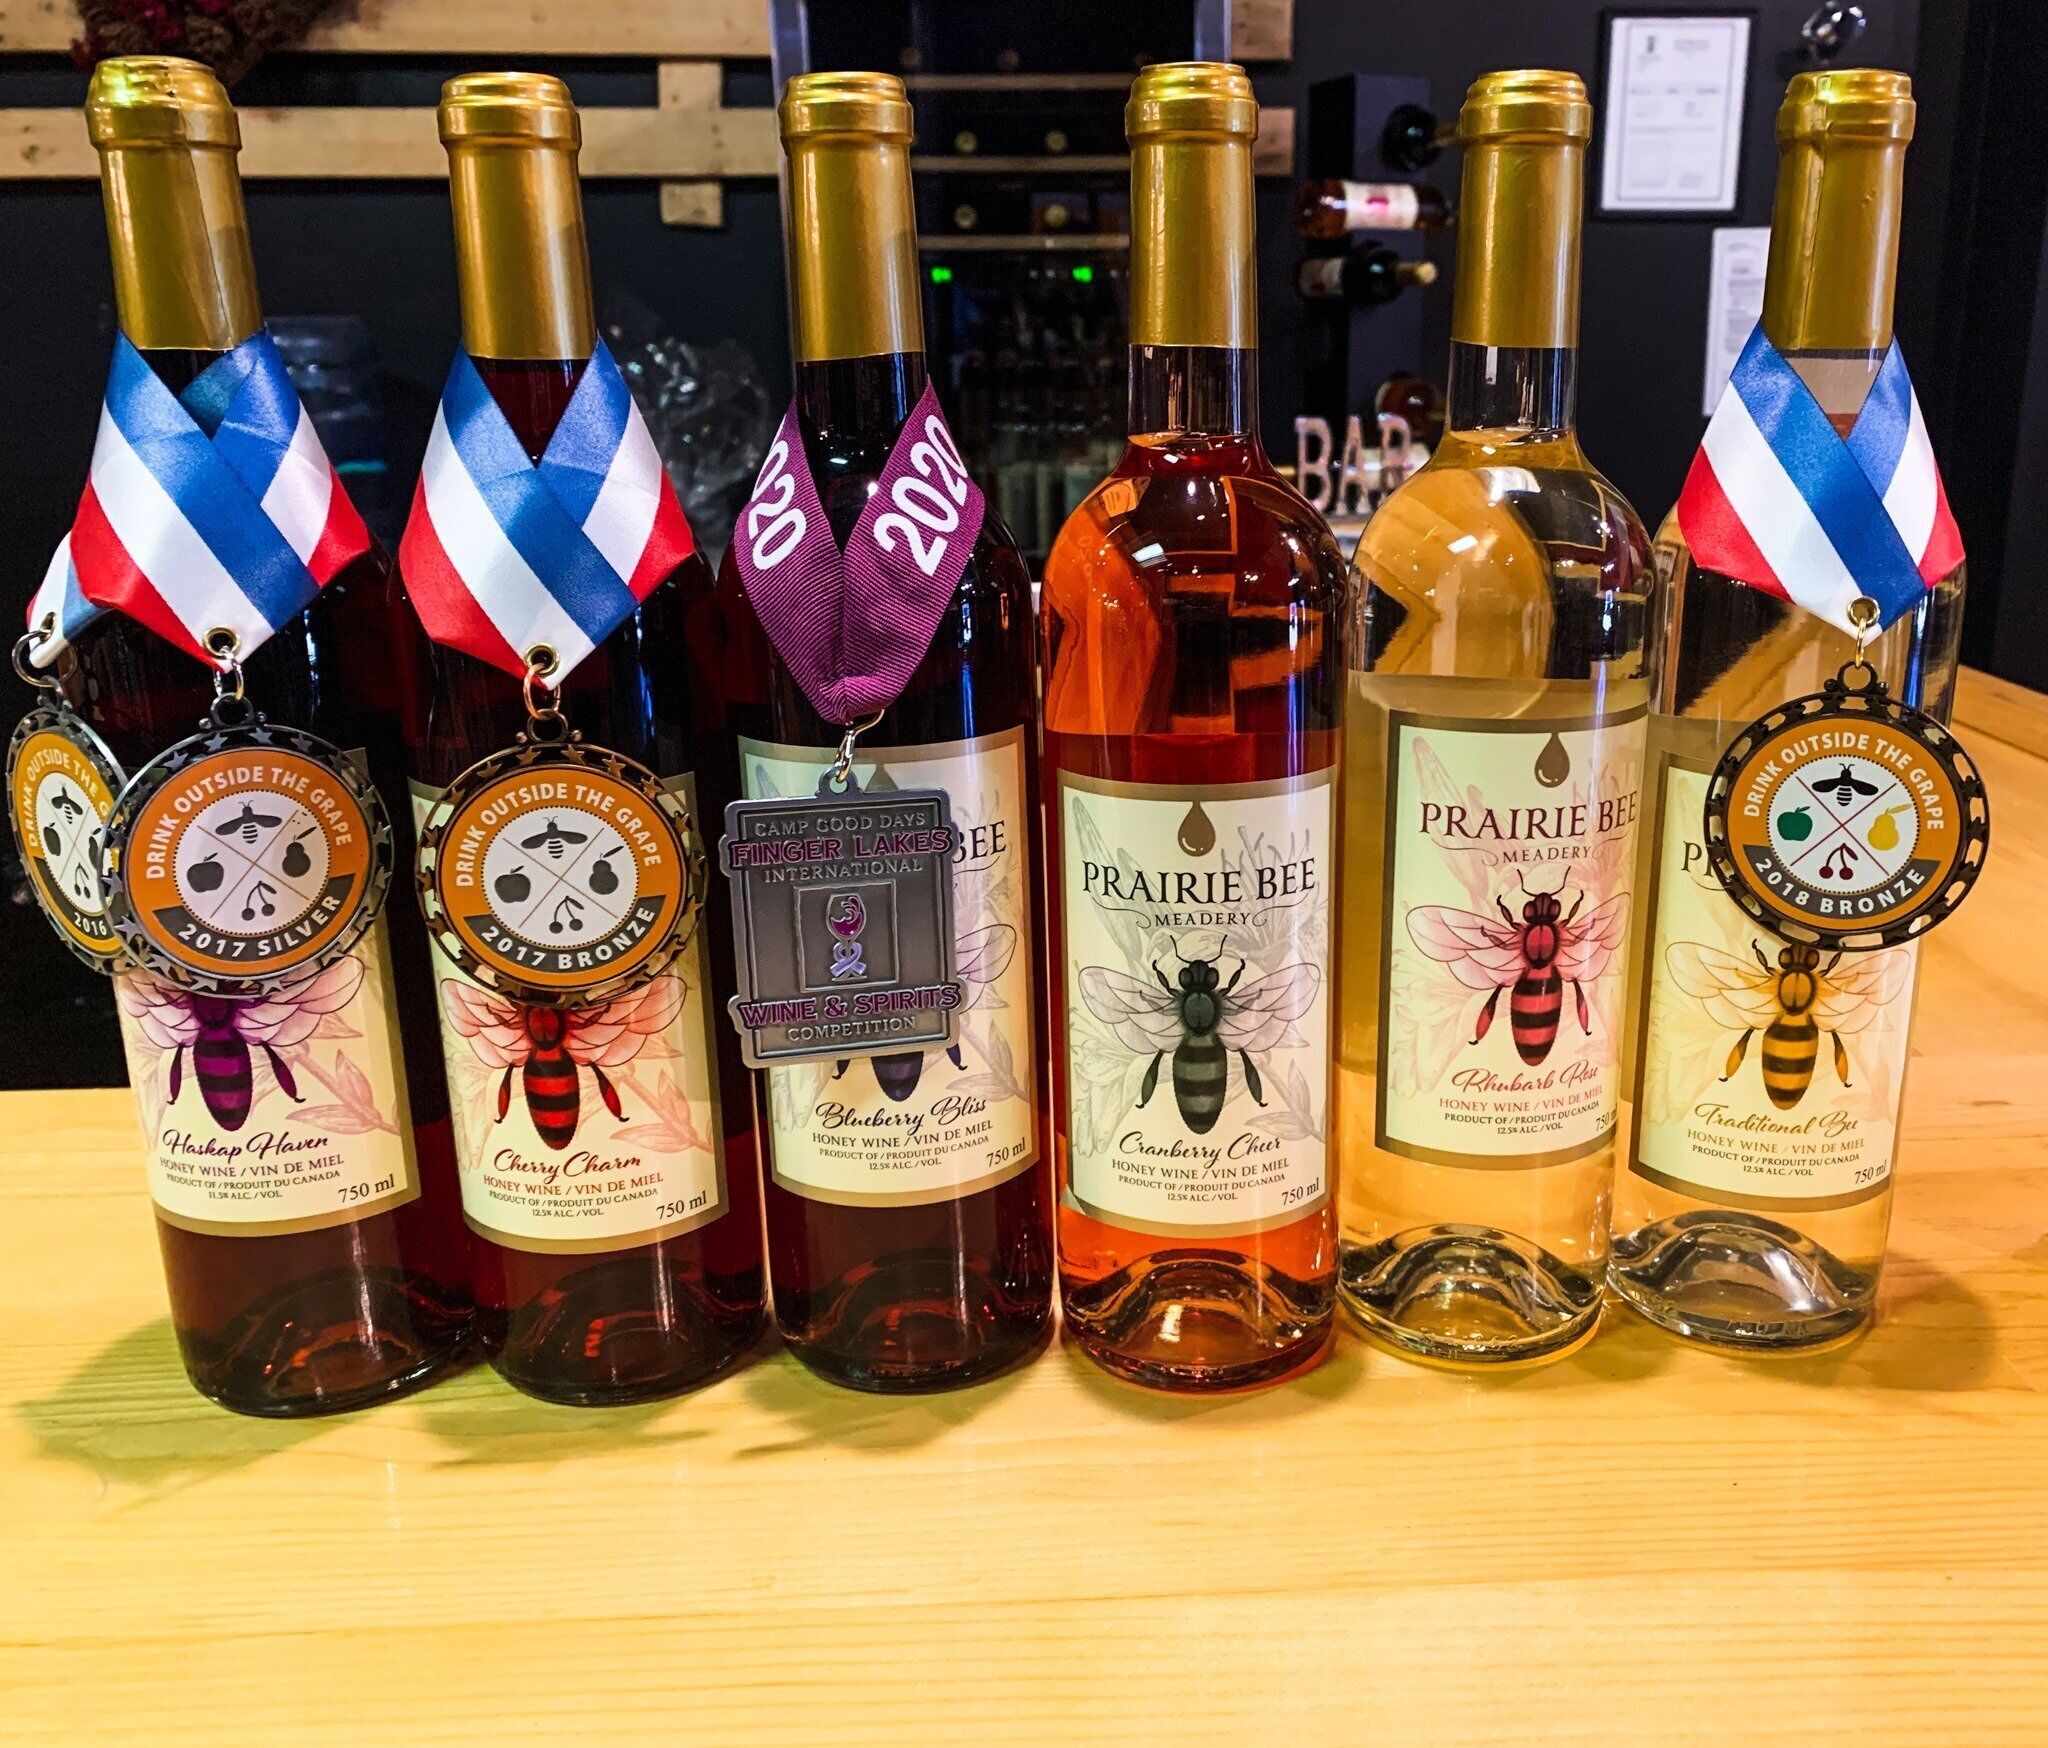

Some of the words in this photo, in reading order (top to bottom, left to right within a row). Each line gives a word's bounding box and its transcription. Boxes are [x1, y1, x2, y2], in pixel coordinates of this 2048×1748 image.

[1294, 415, 1411, 517] BAR
[748, 414, 807, 570] 020
[873, 414, 969, 577] 2020
[26, 749, 71, 782] OUTSIDE
[72, 759, 99, 798] THE
[1744, 760, 1782, 818] DRINK
[1781, 731, 1870, 764] OUTSIDE
[1875, 739, 1913, 770] THE
[1909, 768, 1944, 831] GRAPE
[23, 784, 39, 846] DRINK
[146, 815, 179, 879] DRINK
[174, 765, 263, 813] OUTSIDE
[270, 766, 310, 794] THE
[309, 787, 352, 846] GRAPE
[754, 820, 809, 837] CAMP
[816, 816, 872, 833] GOOD
[880, 812, 925, 828] DAYS
[1419, 801, 1588, 841] PRAIRIE
[1596, 790, 1637, 834] BEE
[456, 825, 486, 887] DRINK
[480, 783, 568, 825] OUTSIDE
[575, 784, 615, 813] THE
[615, 807, 661, 867] GRAPE
[732, 837, 842, 867] FINGER
[855, 830, 951, 858] LAKES
[1502, 846, 1592, 864] MEADERY
[765, 858, 923, 883] INTERNATIONAL
[1082, 860, 1244, 905] PRAIRIE
[1255, 857, 1316, 900] BEE
[1755, 858, 1809, 906] 2018
[1820, 868, 1925, 915] BRONZE
[74, 912, 107, 936] 2016
[179, 923, 246, 958] 2017
[257, 897, 341, 956] SILVER
[1154, 912, 1251, 927] MEADERY
[481, 925, 547, 967] 2017
[558, 907, 655, 970] BRONZE
[739, 1002, 817, 1027] WINE
[825, 996, 847, 1019] &
[854, 986, 960, 1014] SPIRITS
[788, 1016, 916, 1042] COMPETITION
[1451, 1067, 1554, 1093] Rhubarb
[1439, 1098, 1489, 1111] HONEY
[1493, 1101, 1530, 1111] WINE
[1542, 1097, 1565, 1109] VIN
[1568, 1093, 1582, 1104] DE
[1584, 1085, 1602, 1099] MIEL
[1445, 1113, 1492, 1124] PRODUCT
[1515, 1113, 1557, 1124] PRODUIT
[1559, 1110, 1571, 1119] DU
[1571, 1100, 1599, 1115] CANADA
[815, 1101, 925, 1136] Blueberry
[930, 1095, 986, 1126] Bliss
[1546, 1122, 1563, 1131] VOL
[1596, 1112, 1609, 1131] 750
[1694, 1102, 1816, 1135] Traditional
[162, 1128, 242, 1164] Haskap
[246, 1131, 329, 1159] Haven
[812, 1133, 856, 1148] HONEY
[862, 1137, 901, 1148] WINE
[914, 1132, 940, 1146] VIN
[945, 1128, 961, 1141] DE
[965, 1120, 993, 1137] MIEL
[819, 1148, 864, 1160] PRODUCT
[866, 1152, 879, 1160] OF
[886, 1149, 932, 1159] PRODUIT
[934, 1146, 949, 1155] DU
[950, 1135, 990, 1152] CANADA
[1687, 1129, 1735, 1148] HONEY
[1740, 1140, 1778, 1154] WINE
[1792, 1143, 1816, 1154] VIN
[1822, 1143, 1838, 1154] DE
[1840, 1138, 1865, 1152] MIEL
[920, 1158, 941, 1167] VOL
[986, 1147, 1010, 1168] 750
[1012, 1138, 1026, 1158] ml
[1118, 1131, 1222, 1170] Cranberry
[1227, 1132, 1281, 1160] Cheer
[1692, 1145, 1739, 1161] PRODUCT
[1741, 1155, 1754, 1163] OF
[1762, 1158, 1807, 1166] PRODUIT
[1824, 1154, 1860, 1165] CANADA
[160, 1157, 195, 1175] HONEY
[199, 1165, 237, 1178] WINE
[249, 1164, 278, 1176] VIN
[284, 1161, 304, 1174] DE
[308, 1154, 345, 1171] MIEL
[166, 1173, 202, 1187] PRODUCT
[224, 1180, 271, 1190] PRODUIT
[274, 1179, 290, 1188] DU
[293, 1170, 340, 1185] CANADA
[493, 1148, 561, 1185] Cherry
[563, 1151, 641, 1178] Charm
[1112, 1158, 1156, 1176] HONEY
[1160, 1168, 1198, 1180] WINE
[1211, 1166, 1237, 1179] VIN
[1241, 1164, 1258, 1177] DE
[1262, 1158, 1290, 1174] MIEL
[1854, 1167, 1874, 1185] 750
[1875, 1159, 1887, 1177] ml
[260, 1190, 284, 1199] VOL
[338, 1182, 370, 1203] 750
[375, 1173, 396, 1195] ml
[484, 1175, 520, 1192] HONEY
[525, 1184, 561, 1195] WINE
[575, 1183, 602, 1194] VIN
[608, 1180, 625, 1193] DE
[630, 1173, 664, 1189] MIEL
[1118, 1175, 1162, 1190] PRODUCT
[1184, 1183, 1229, 1191] PRODUIT
[1231, 1181, 1246, 1190] DU
[1247, 1173, 1286, 1189] CANADA
[1281, 1188, 1304, 1206] 750
[1306, 1177, 1320, 1193] ml
[489, 1190, 526, 1205] PRODUCT
[528, 1198, 540, 1206] OF
[548, 1199, 593, 1207] PRODUIT
[596, 1197, 612, 1205] DU
[613, 1188, 658, 1203] CANADA
[656, 1200, 685, 1220] 750
[689, 1190, 707, 1210] ml
[582, 1208, 604, 1216] VOL
